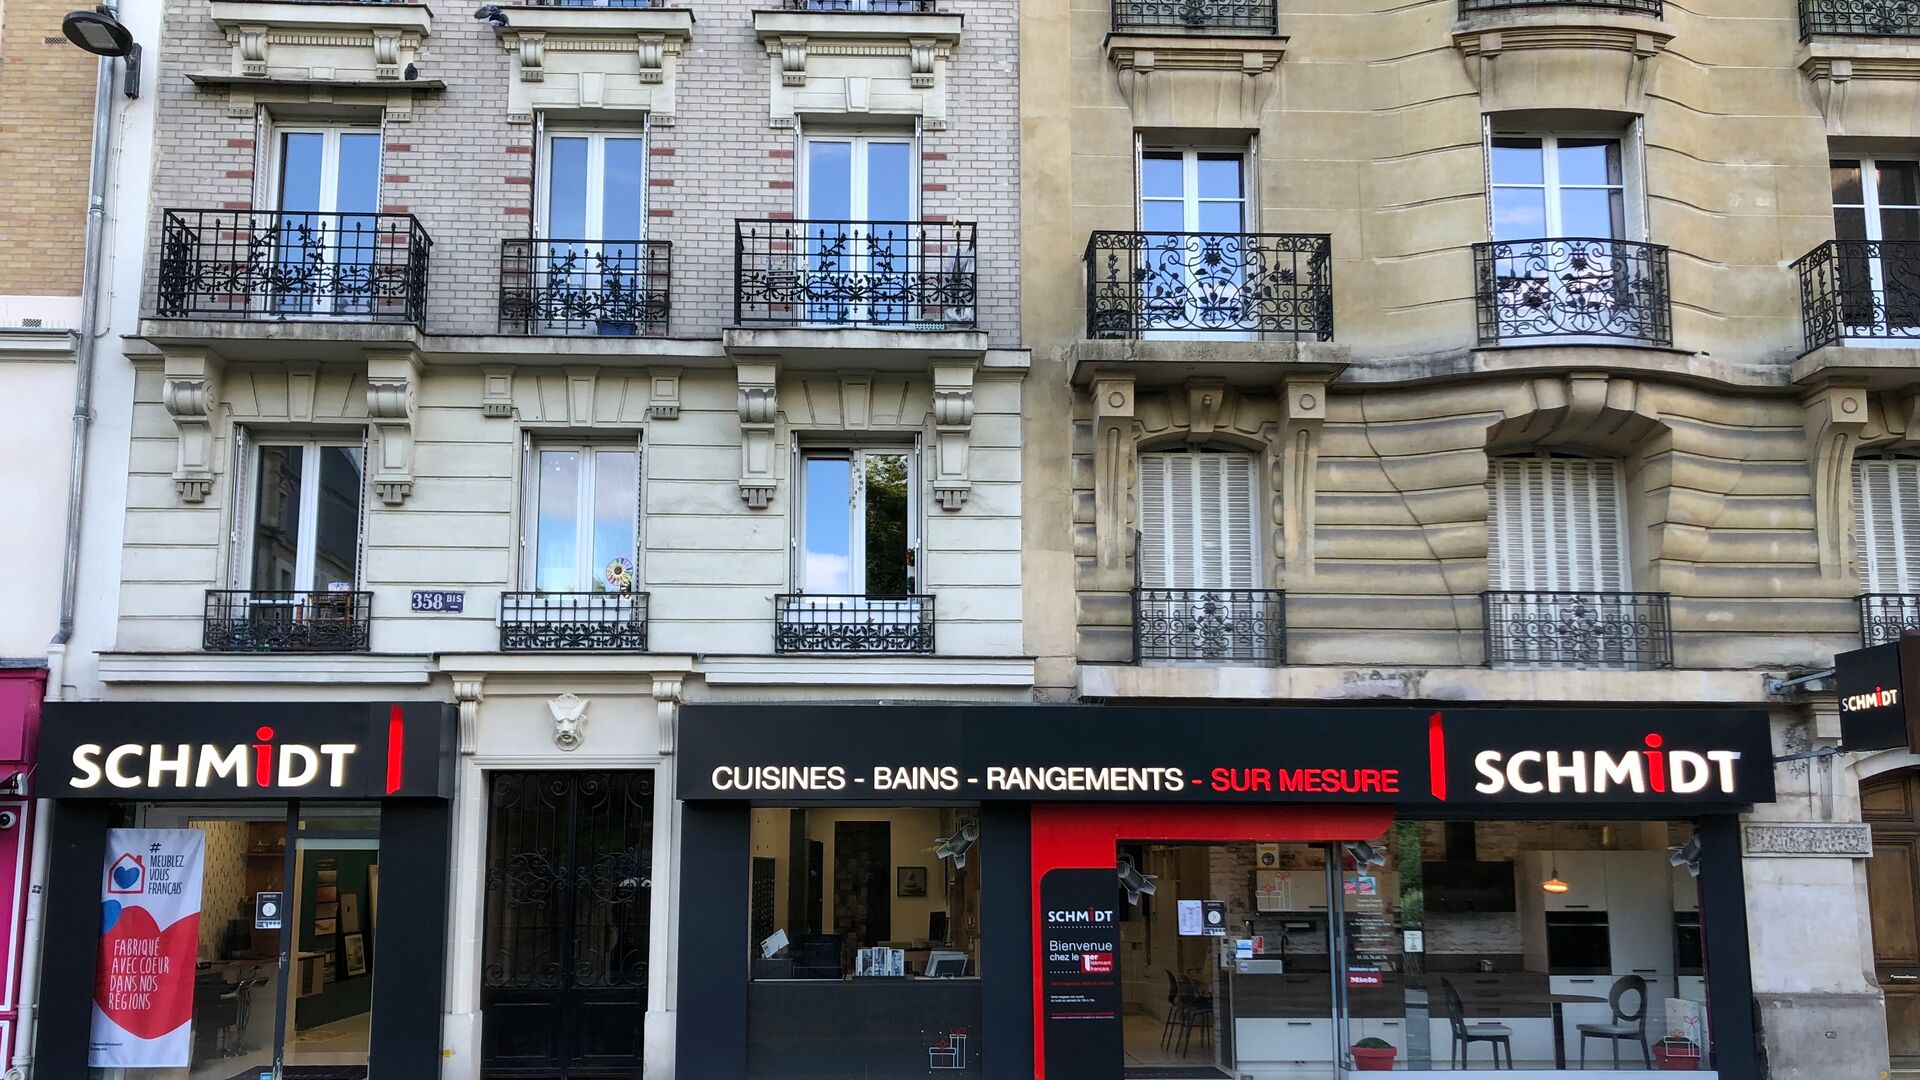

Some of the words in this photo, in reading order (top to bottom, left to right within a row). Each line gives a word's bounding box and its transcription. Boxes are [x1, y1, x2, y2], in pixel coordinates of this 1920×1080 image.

[412, 593, 443, 610] 358
[446, 595, 463, 603] BIS
[711, 766, 846, 791] CUISINES
[873, 766, 959, 791] BAINS
[986, 766, 1184, 792] RANGEMENTS
[1211, 768, 1271, 793] SUR
[1279, 768, 1399, 793] MESURE
[149, 842, 162, 853] #
[150, 855, 184, 868] MEUBLEZ
[149, 868, 170, 881] VOUS
[148, 882, 183, 895] FRANÇAIS
[114, 936, 160, 956] FABRIQUÉ
[1049, 940, 1113, 951] Bienvenue
[1049, 953, 1070, 961] chez
[1071, 952, 1079, 961] le
[111, 957, 137, 974] AVEC
[140, 956, 170, 974] COEUR
[110, 974, 138, 992] DANS
[139, 975, 158, 992] NOS
